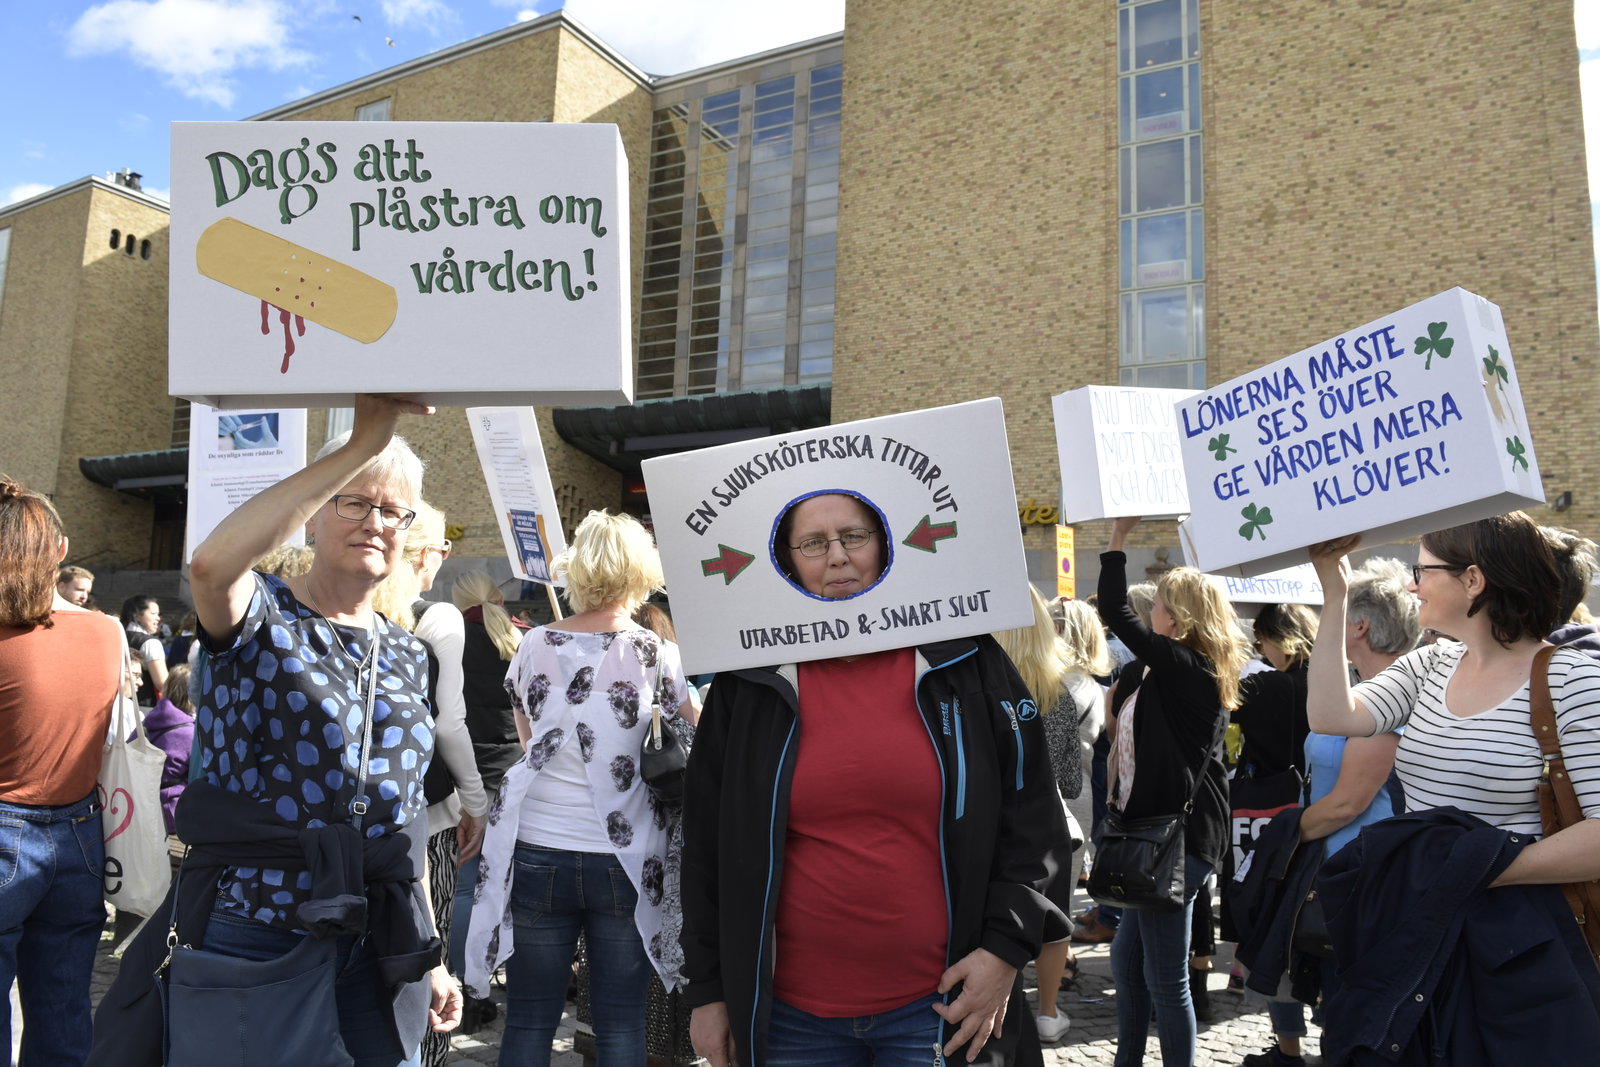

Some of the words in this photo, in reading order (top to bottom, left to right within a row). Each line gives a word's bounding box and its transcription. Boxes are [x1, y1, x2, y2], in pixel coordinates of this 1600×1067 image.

[205, 138, 338, 224] Dags
[353, 139, 432, 182] att
[350, 186, 526, 251] plåstra
[539, 195, 607, 238] om
[410, 247, 599, 301] vården!
[1093, 390, 1119, 425] NU
[1120, 390, 1158, 426] TAR
[1182, 366, 1306, 438] LÖNERNA
[1308, 325, 1405, 389] MÅSTE
[1257, 400, 1309, 445] SES
[1317, 370, 1398, 419] ÖVER
[1100, 431, 1136, 467] MOT
[1213, 464, 1250, 501] GE
[1254, 422, 1365, 486] VÅRDEN
[1373, 392, 1463, 449] MERA
[1312, 441, 1450, 511] KLÖVER!
[685, 500, 719, 536] EN
[711, 434, 875, 508] SJUKSKÖTERSKA
[881, 437, 942, 490] TITTAR
[932, 485, 958, 513] UT
[1108, 469, 1140, 505] OCH
[739, 618, 850, 649] UTARBETAD
[879, 600, 943, 631] SNART
[947, 590, 991, 618] SLUT
